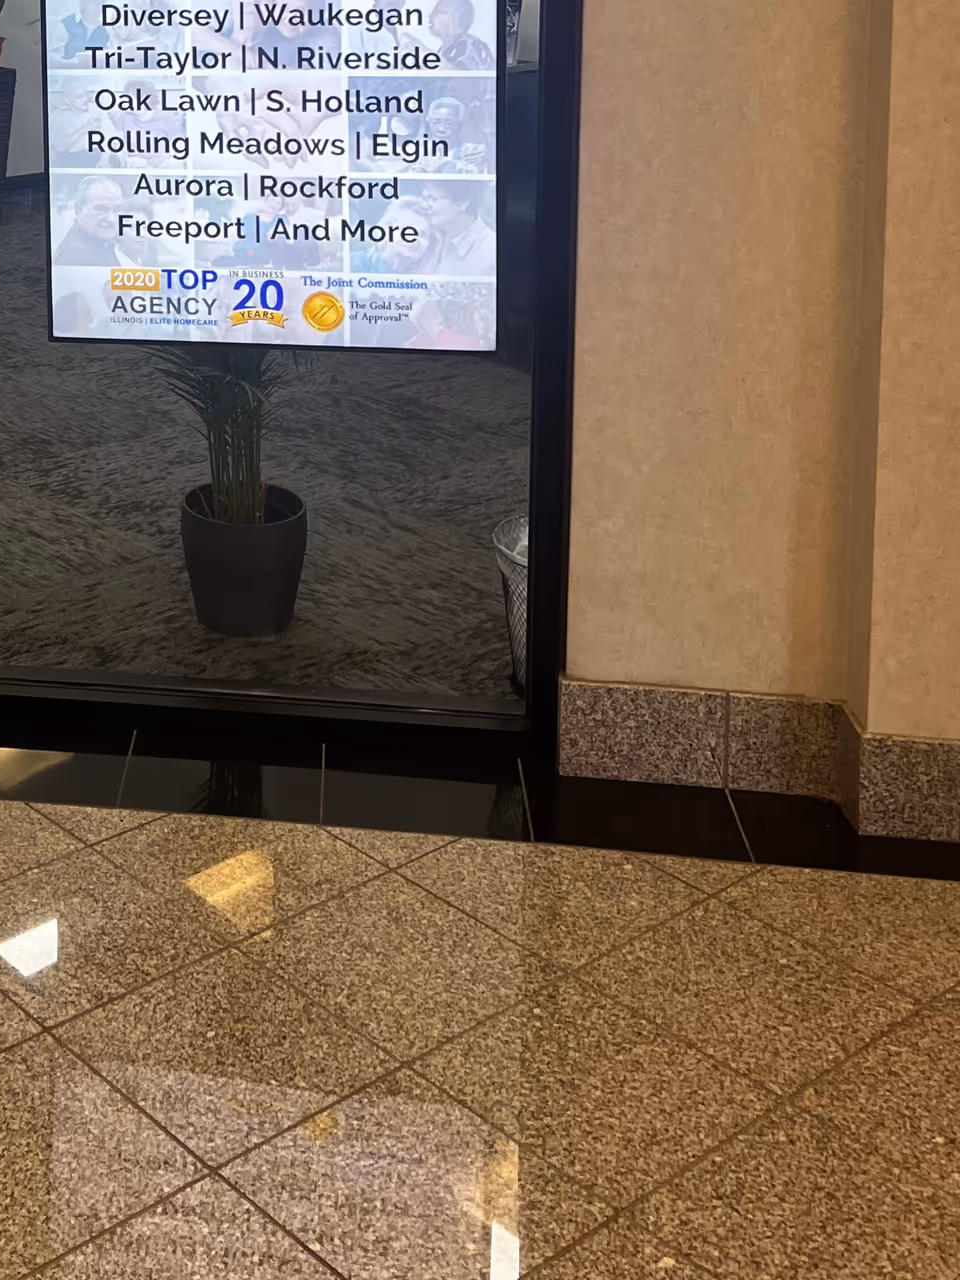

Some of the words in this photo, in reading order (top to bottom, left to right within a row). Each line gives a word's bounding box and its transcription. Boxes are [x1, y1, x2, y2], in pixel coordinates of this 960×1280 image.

[101, 4, 229, 35] Diversey
[254, 3, 423, 32] Waukegan
[85, 46, 232, 77] Tri-Taylor
[257, 48, 287, 70] N.
[296, 47, 441, 70] Riverside
[94, 89, 152, 112] Oak
[161, 90, 241, 113] Lawn
[265, 90, 291, 113] S.
[302, 90, 423, 114] Holland
[87, 130, 191, 160] Rolling
[200, 131, 346, 156] Meadows
[372, 132, 450, 164] Elgin
[134, 174, 234, 199] Aurora
[259, 175, 400, 200] Rockford
[118, 215, 246, 245] Freeport
[270, 217, 331, 242] And
[341, 219, 419, 243] More
[113, 272, 156, 287] 2020
[161, 269, 218, 291] TOP
[229, 270, 239, 278] IN
[242, 270, 284, 279] BUSINESS
[301, 276, 323, 287] The
[327, 276, 353, 289] Joint
[358, 278, 428, 290] Commission
[111, 296, 218, 316] AGENCY
[232, 279, 284, 311] 20
[348, 301, 366, 310] The
[370, 302, 392, 310] Gold
[395, 302, 413, 311] Seal
[174, 318, 219, 326] HOMECARE
[240, 310, 275, 320] YEARS
[349, 312, 359, 320] of
